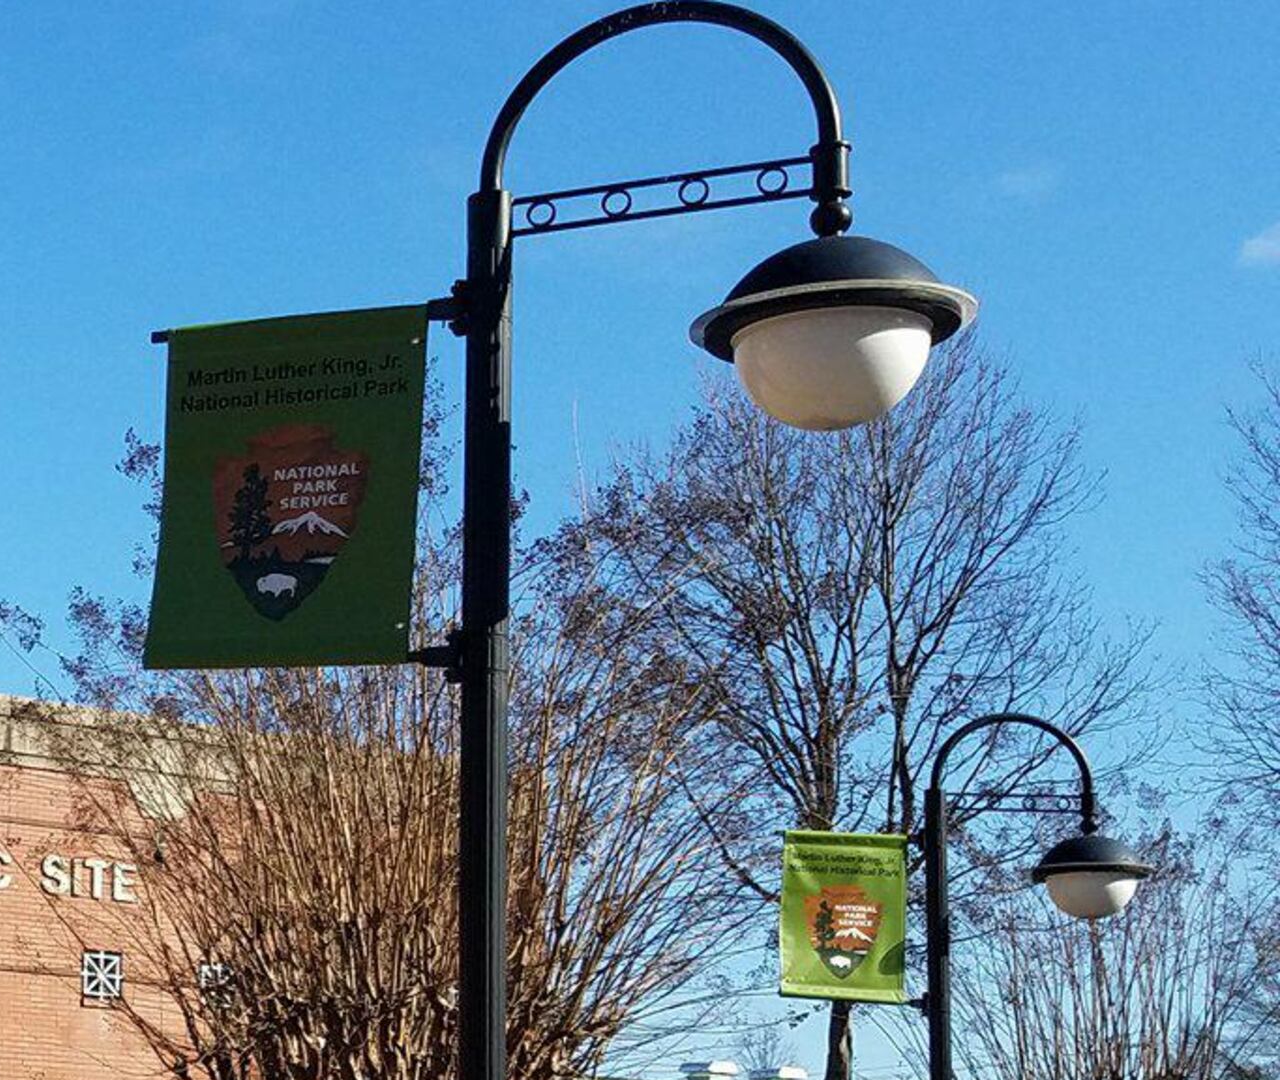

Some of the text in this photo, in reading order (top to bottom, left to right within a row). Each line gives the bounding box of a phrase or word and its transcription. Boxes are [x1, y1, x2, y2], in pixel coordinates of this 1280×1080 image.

[187, 354, 403, 387] Martin Luther King, Jr.
[180, 377, 409, 413] National Historical Park
[274, 463, 360, 481] NATIONAL
[293, 479, 338, 494] PARK
[280, 493, 349, 511] SERVICE
[40, 853, 139, 903] SITE
